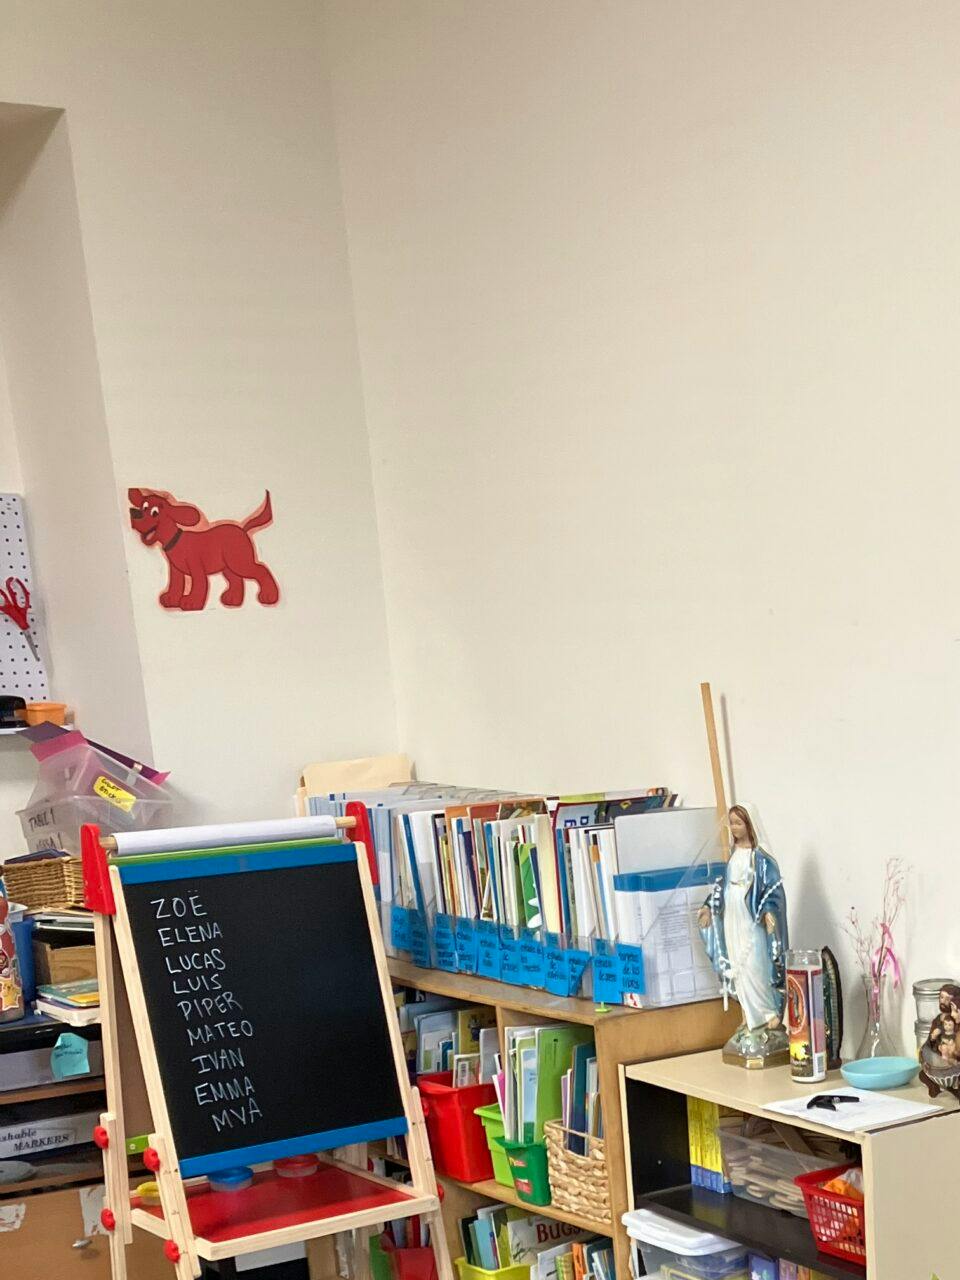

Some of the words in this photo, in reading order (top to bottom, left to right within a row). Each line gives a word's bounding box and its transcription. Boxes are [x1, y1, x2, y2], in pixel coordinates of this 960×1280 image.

[158, 922, 225, 947] ELENA
[165, 948, 226, 974] LUCAS
[172, 974, 222, 995] LUIS
[177, 991, 243, 1021] PIPER
[186, 1020, 254, 1047] MATEO
[191, 1047, 245, 1074] IVAN
[195, 1076, 256, 1106] EMMA
[14, 1133, 70, 1150] MARKERS
